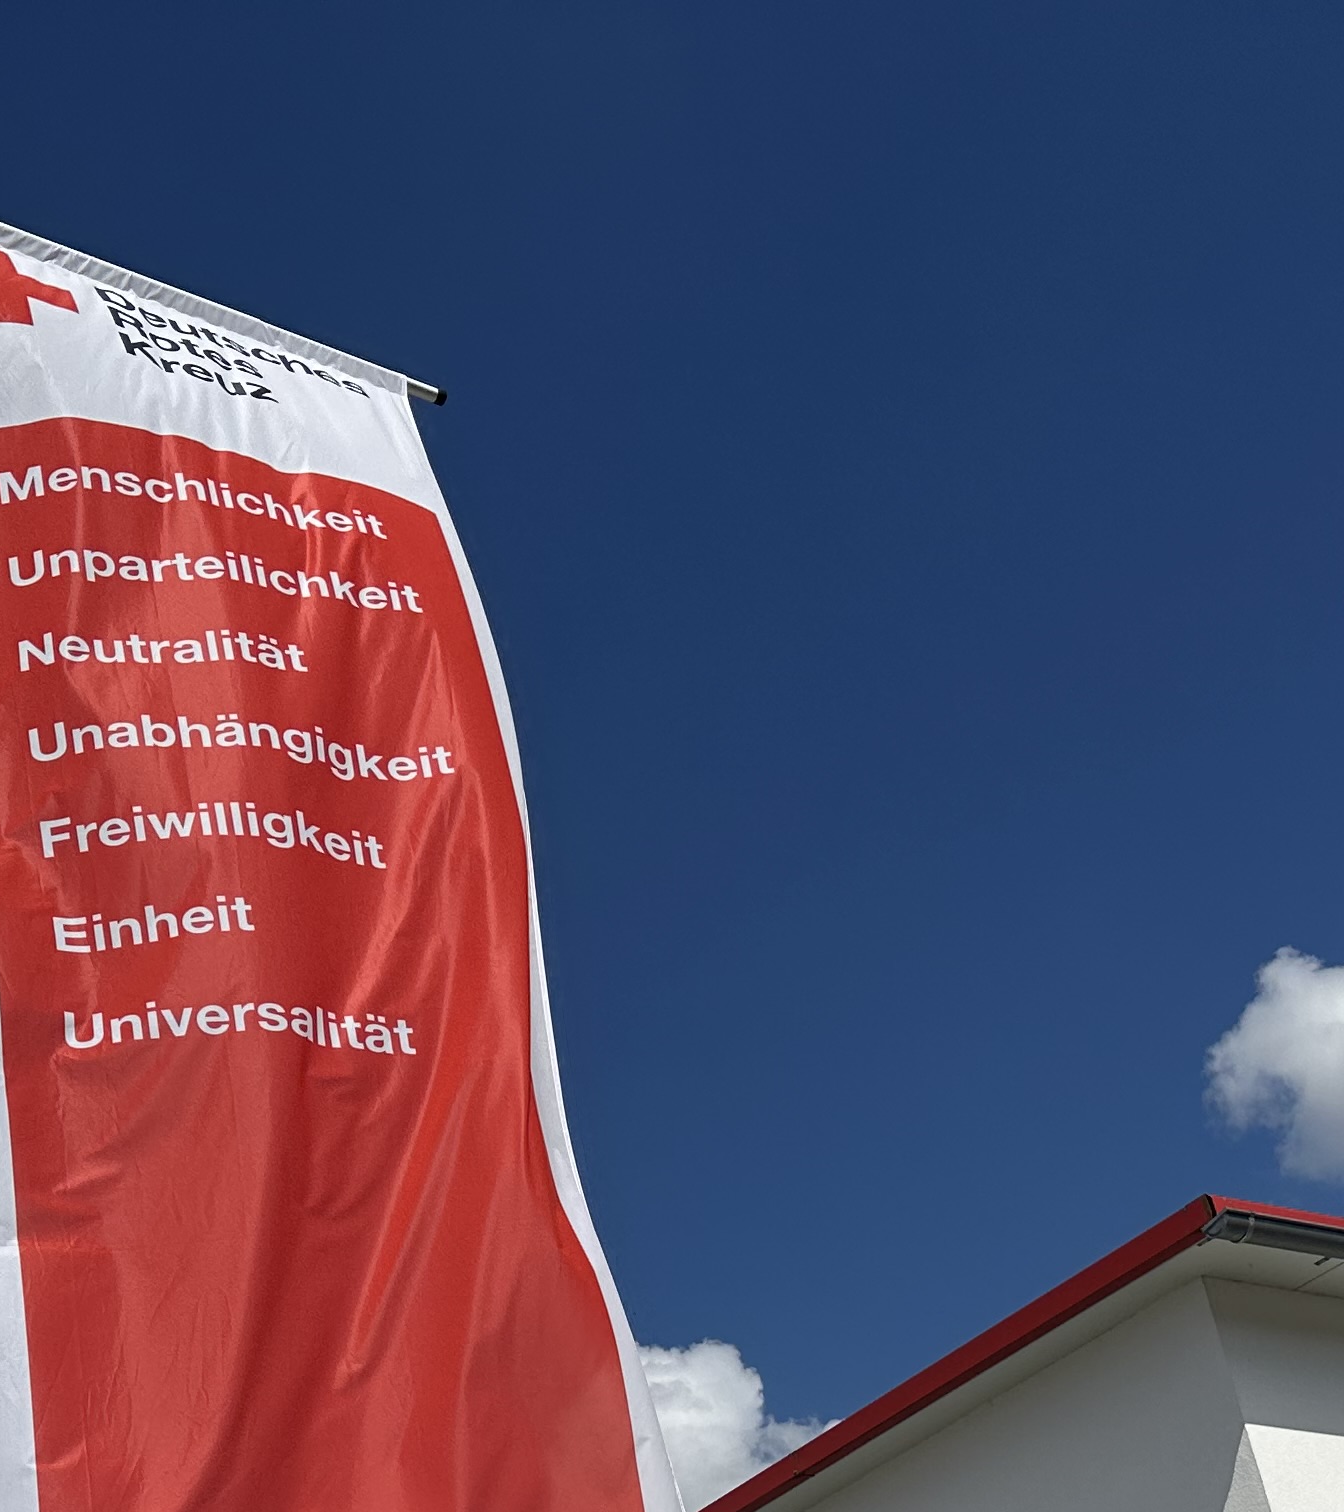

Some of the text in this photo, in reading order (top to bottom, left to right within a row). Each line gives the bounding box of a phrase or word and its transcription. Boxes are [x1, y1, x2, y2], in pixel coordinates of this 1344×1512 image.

[94, 286, 370, 399] Deutsches
[107, 305, 263, 378] Rotes
[118, 332, 279, 403] Kreuz
[8, 549, 423, 614] Unparteilichkeit
[18, 630, 308, 672] Neutralität
[28, 714, 455, 781] Unabhängigkeit
[39, 802, 386, 869] Freiwilligkeit
[52, 895, 255, 954] Einheit
[63, 1001, 417, 1055] Universalität
